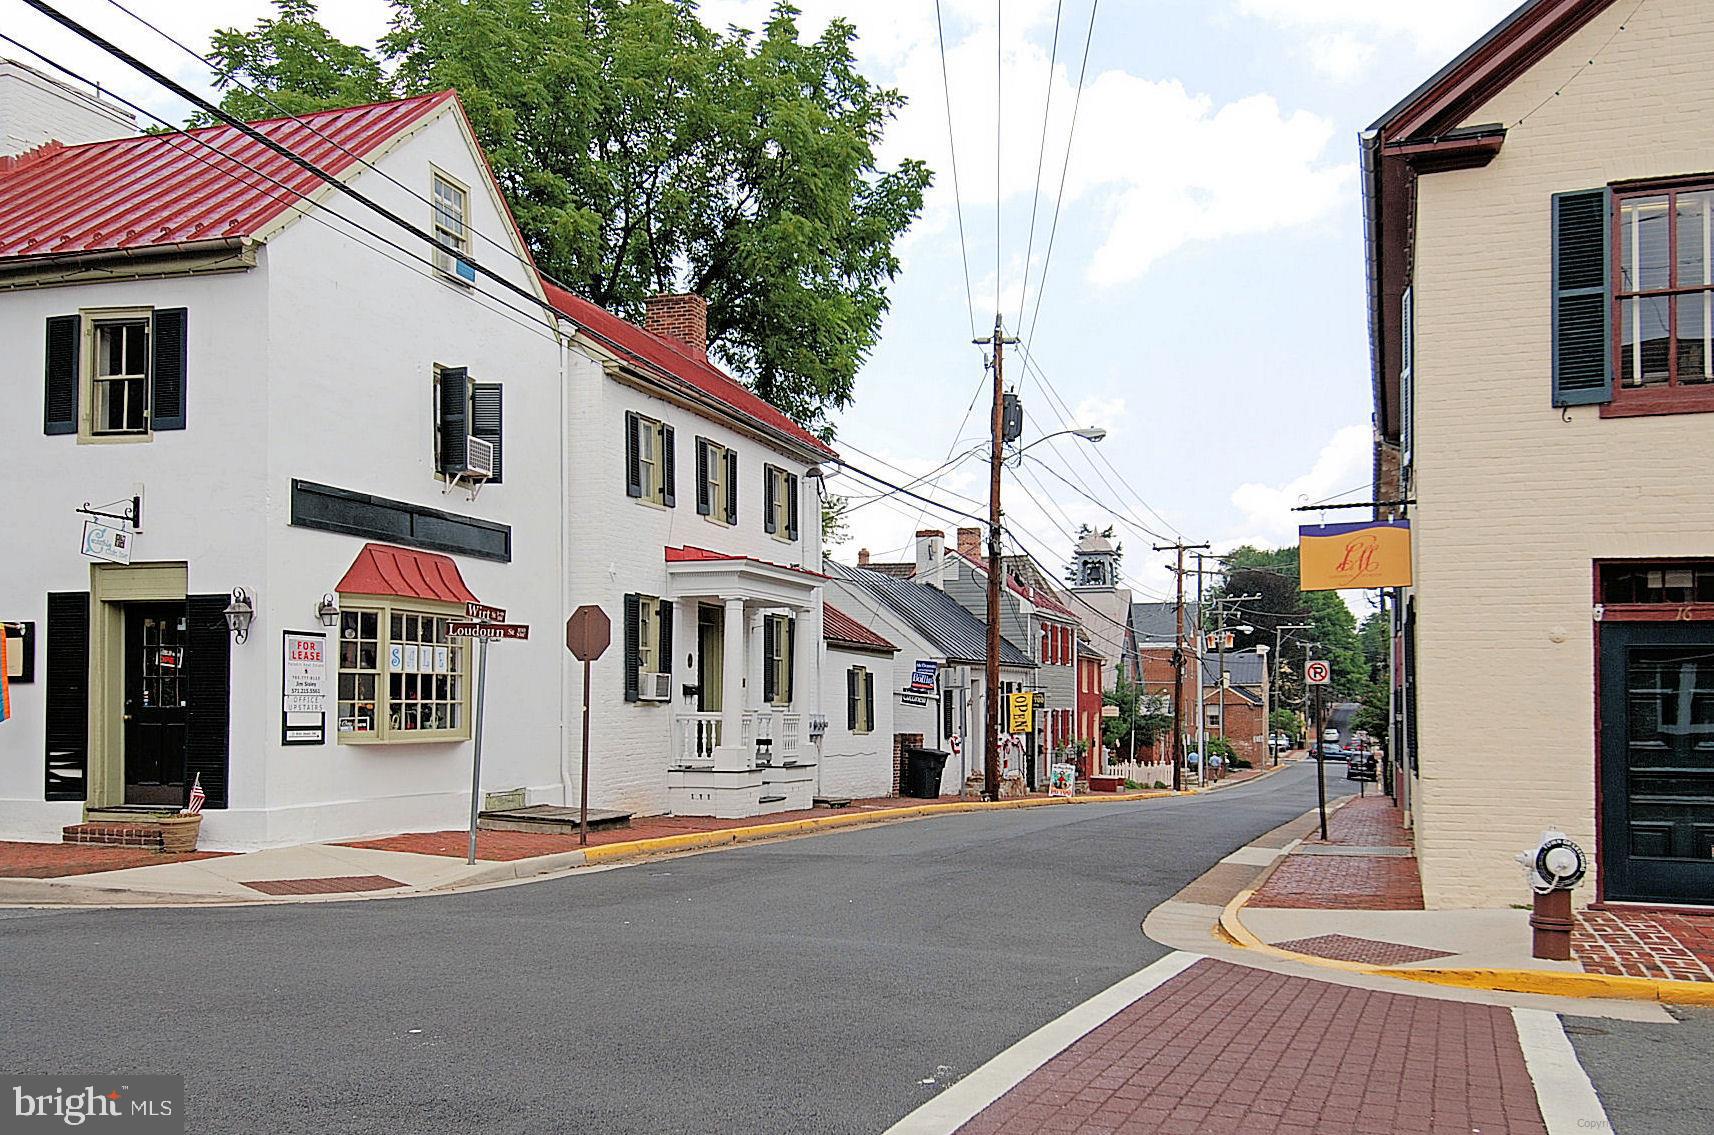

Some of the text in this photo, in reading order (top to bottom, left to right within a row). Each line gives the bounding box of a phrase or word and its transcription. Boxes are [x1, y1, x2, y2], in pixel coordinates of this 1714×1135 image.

[468, 603, 490, 620] Wirt
[1676, 606, 1692, 621] 16
[448, 623, 505, 638] Loudoun
[507, 628, 516, 636] St
[297, 641, 316, 651] FOR
[292, 651, 321, 661] LEASE
